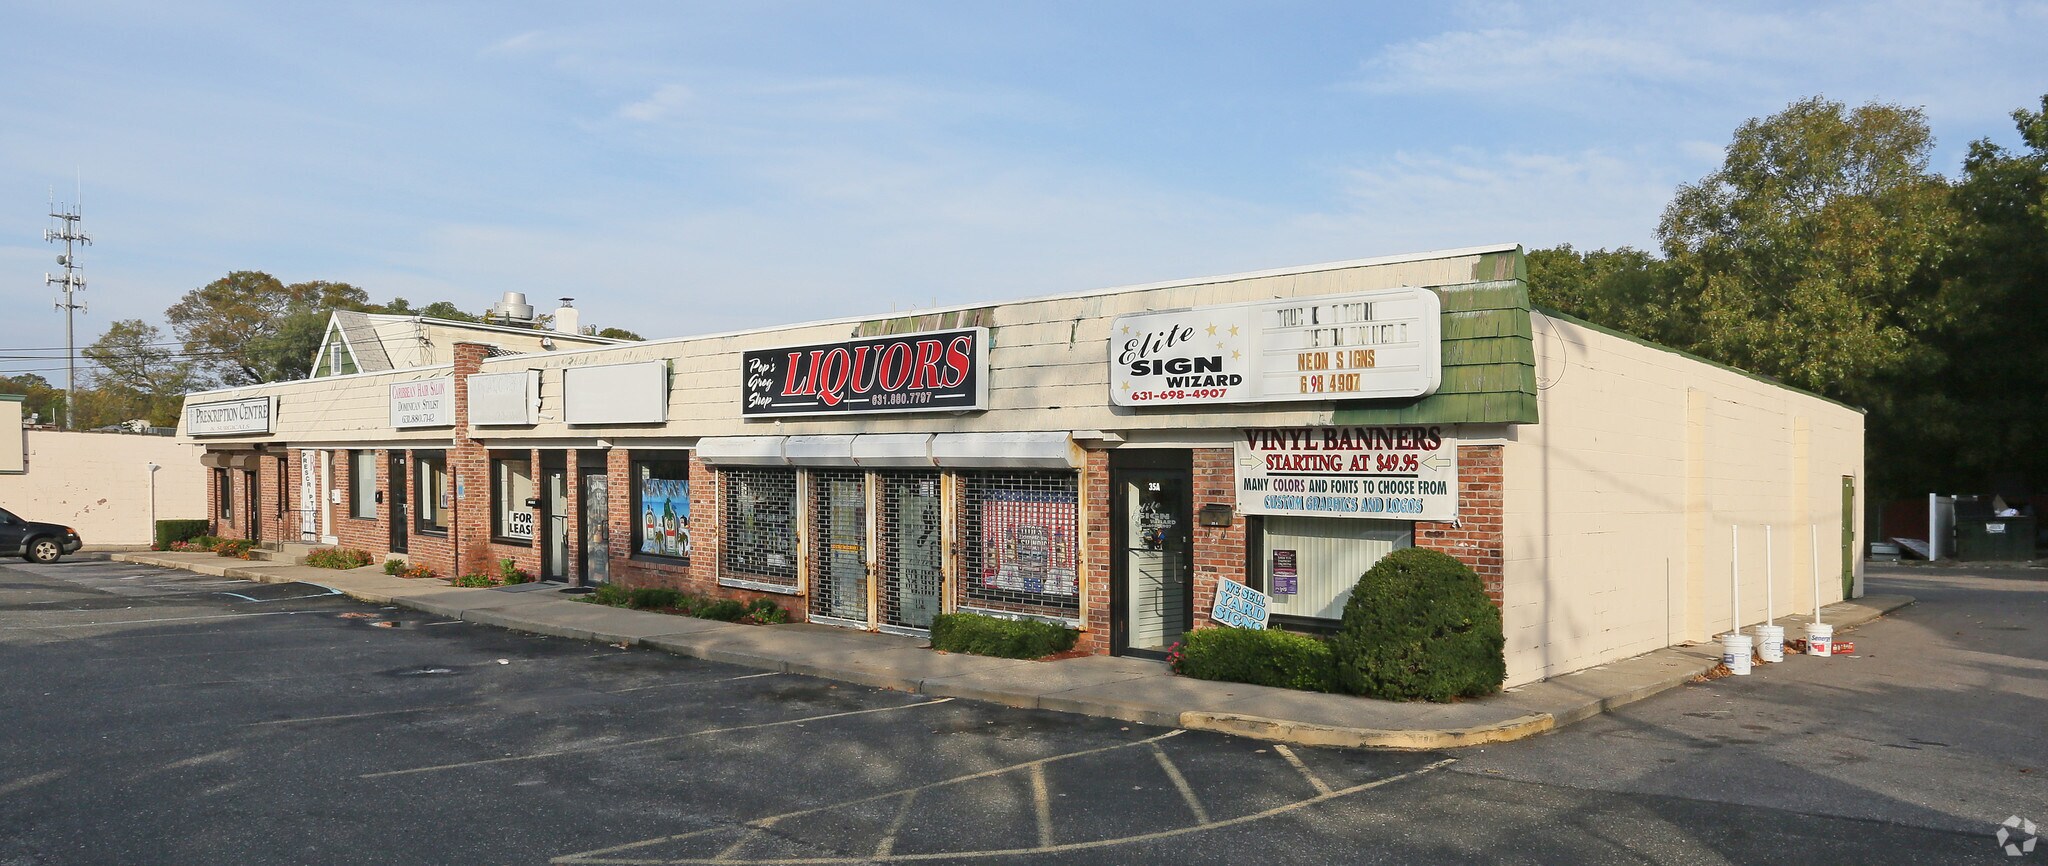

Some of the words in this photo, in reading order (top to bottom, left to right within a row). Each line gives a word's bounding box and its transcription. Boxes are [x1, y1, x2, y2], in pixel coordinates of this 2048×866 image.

[1118, 323, 1195, 365] Elite
[780, 335, 973, 406] LIQUORS
[1130, 356, 1222, 376] SIGN
[1298, 352, 1328, 371] NEON
[1166, 374, 1242, 388] WIZARD
[1330, 373, 1360, 392] 4907
[748, 391, 773, 409] Shop
[1132, 389, 1227, 400] 631-698-4907
[196, 407, 238, 424] PRESCRIPTION
[240, 403, 269, 420] CENTRE
[1243, 428, 1318, 451] VINYL
[1322, 426, 1442, 451] BANNERS
[1266, 454, 1343, 472] STARTING
[1349, 455, 1370, 472] AT
[1376, 453, 1419, 472] $49.95
[1148, 483, 1160, 491] 35A
[1243, 478, 1269, 491] MANY
[1273, 479, 1305, 492] COLORS
[1308, 480, 1327, 493] AND
[1331, 480, 1358, 493] FONTS
[1363, 480, 1374, 494] TO
[1378, 481, 1415, 494] CHOOSE
[1418, 481, 1447, 495] FROM
[1264, 494, 1304, 510] CUSTOM
[1306, 496, 1358, 512] GRAPHICS
[1360, 497, 1384, 513] AND
[1386, 497, 1424, 514] LOGOS
[513, 512, 532, 523] FOR
[509, 523, 533, 535] LEAS
[1225, 580, 1241, 597] WE
[1241, 586, 1265, 607] SELL
[1220, 591, 1265, 621] YARD
